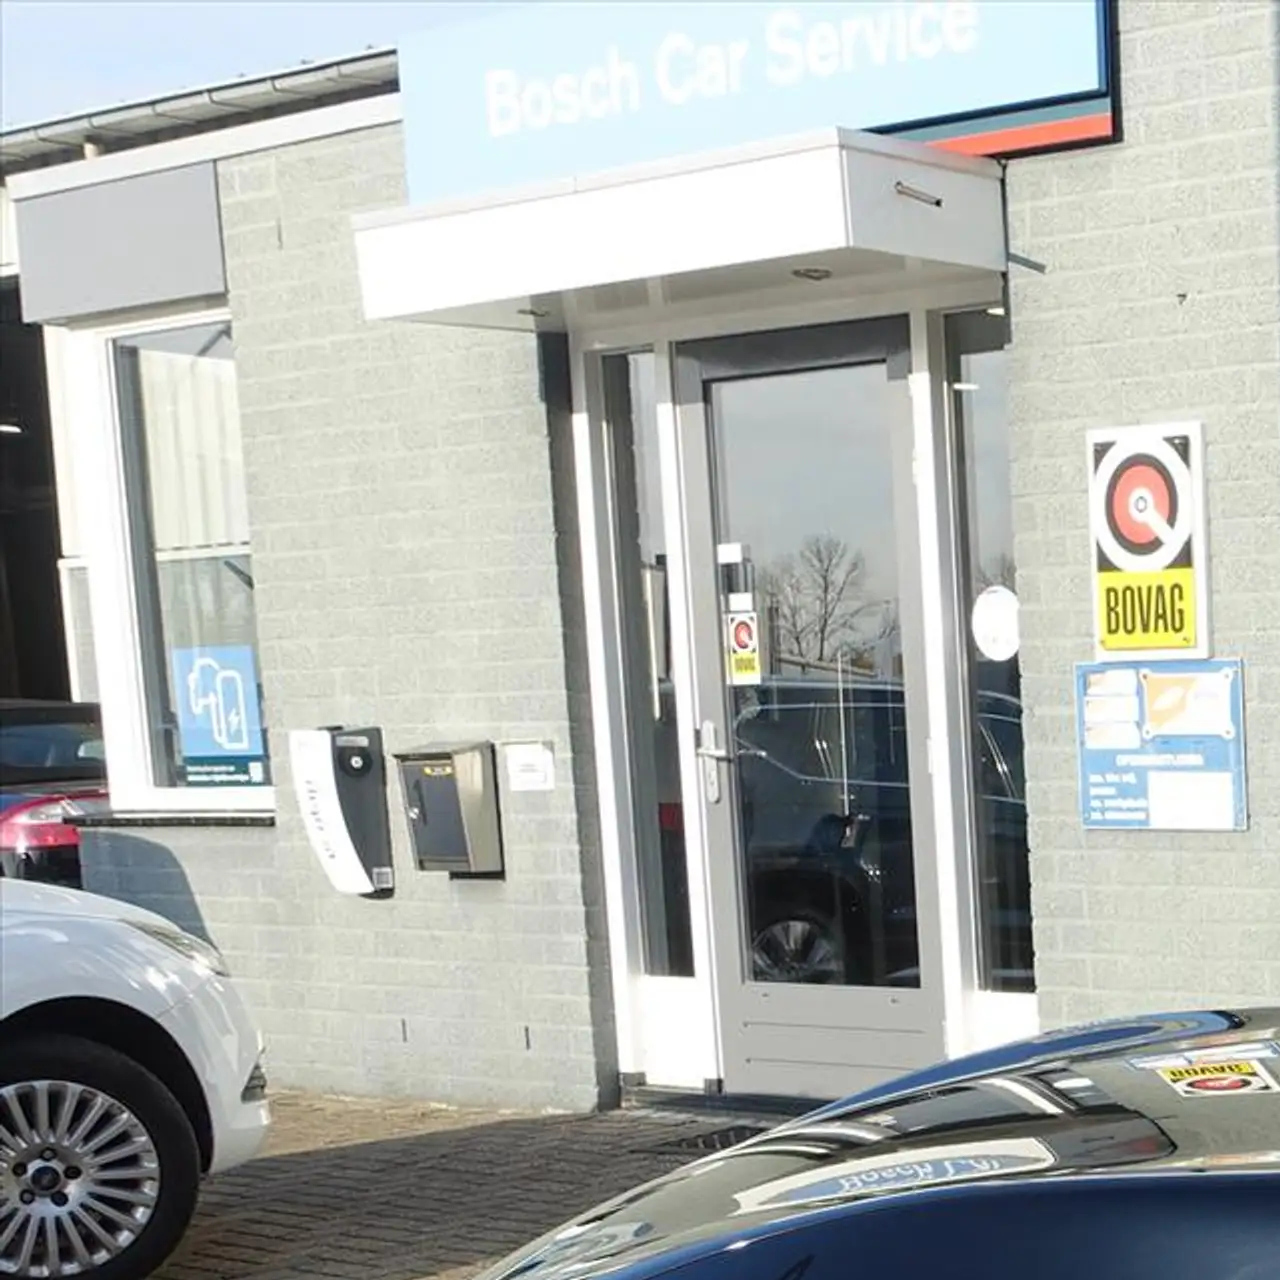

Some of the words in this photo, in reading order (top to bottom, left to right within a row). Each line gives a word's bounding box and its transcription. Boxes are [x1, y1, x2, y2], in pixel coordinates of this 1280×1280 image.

[484, 45, 641, 137] Bosch
[655, 32, 750, 104] Car
[764, 0, 981, 86] Service
[1105, 582, 1185, 635] BOVAG
